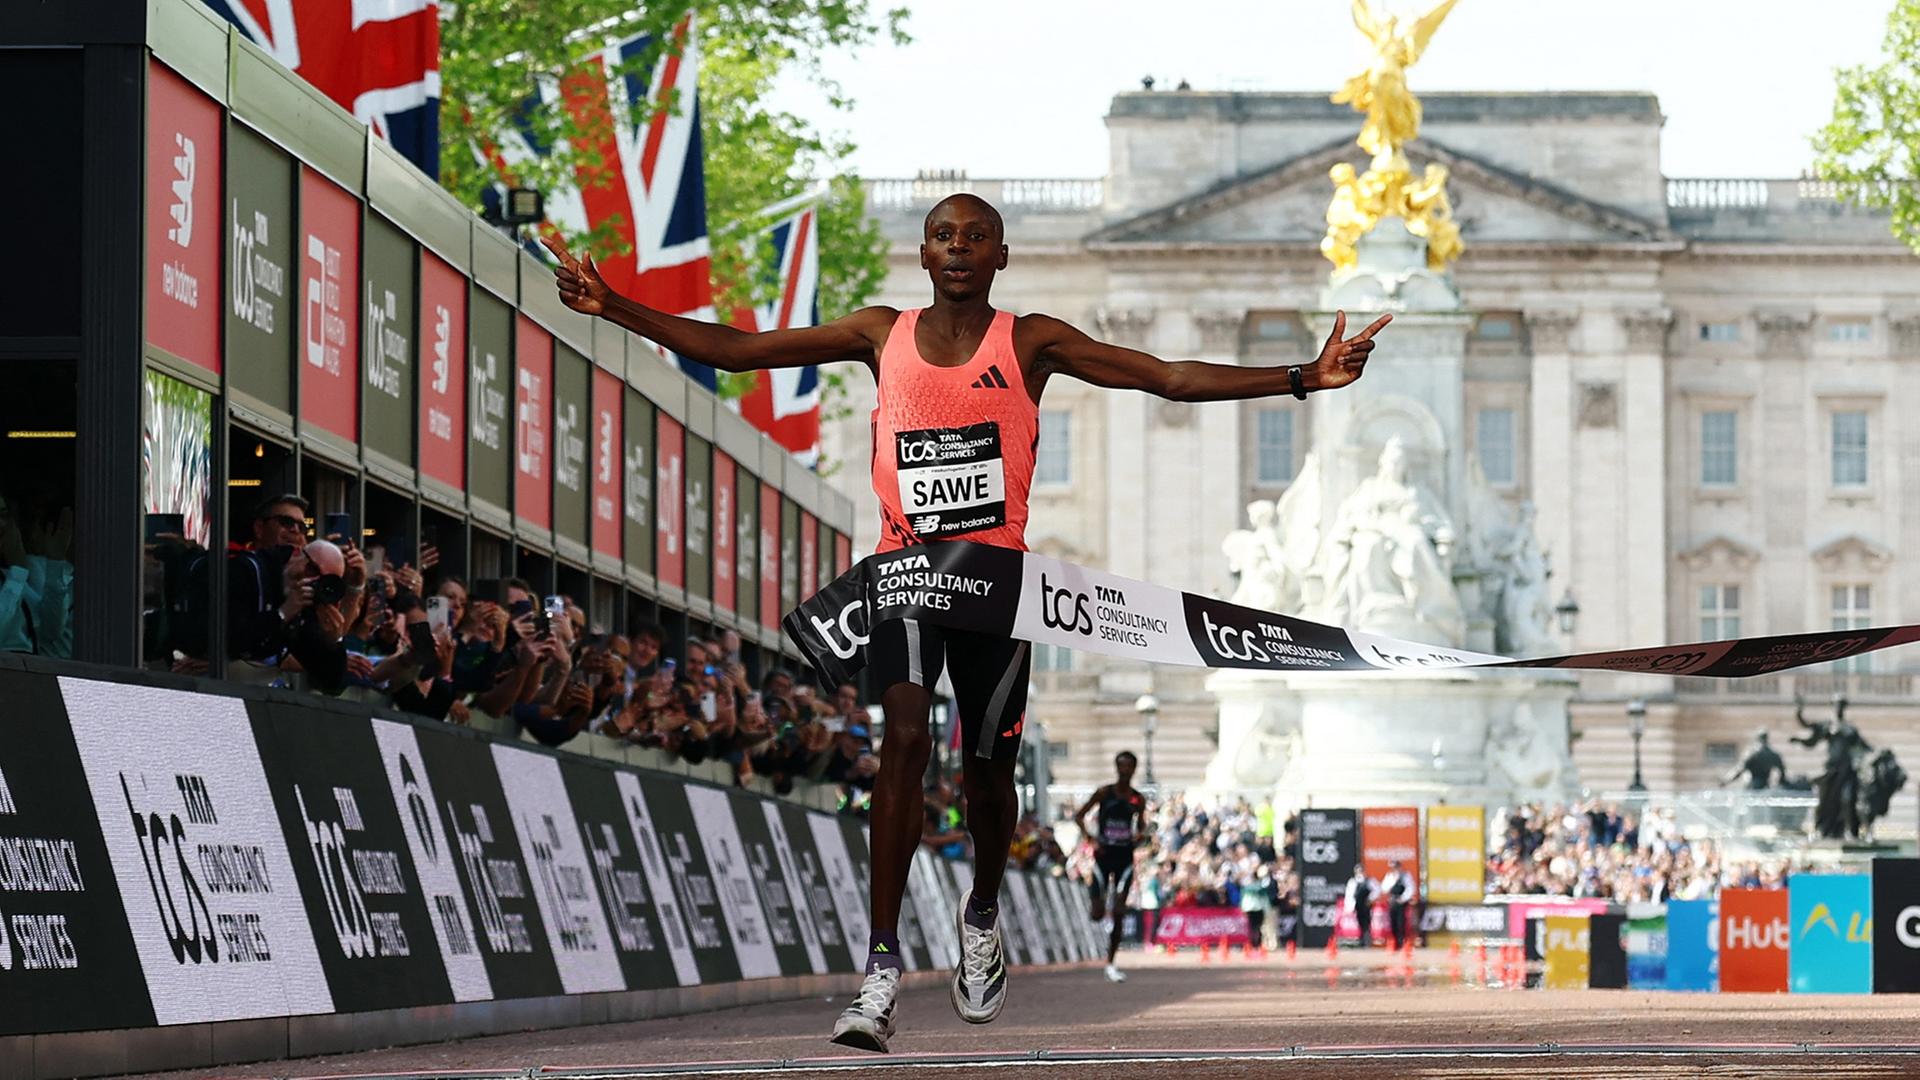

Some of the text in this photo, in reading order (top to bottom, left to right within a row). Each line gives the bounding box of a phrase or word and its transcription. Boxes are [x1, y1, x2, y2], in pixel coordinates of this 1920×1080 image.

[233, 197, 254, 323] tcs
[900, 437, 937, 463] tcs
[939, 434, 963, 442] TATA
[939, 437, 994, 451] CONSULTANCY
[940, 448, 976, 460] SERVICES
[913, 473, 989, 507] SAWE
[941, 515, 996, 532] new balance
[876, 554, 931, 576] TATA
[876, 571, 993, 597] CONSULTANCY
[1095, 585, 1126, 606] TATA
[876, 590, 953, 611] SERVICES
[1041, 572, 1093, 636] tcs
[810, 599, 870, 660] tc
[1096, 606, 1168, 634] CONSULTANCY
[1257, 622, 1293, 641] TATA
[1099, 625, 1148, 648] SERVICES
[1202, 611, 1271, 662] tcs
[1265, 641, 1345, 661] CONSULTANCY
[1274, 655, 1332, 667] SERVICES
[175, 774, 218, 825] TATA
[333, 786, 365, 831] TATA
[1302, 839, 1340, 863] tcs
[119, 771, 219, 965] tcs
[198, 844, 273, 893] CONSULTANCY
[294, 783, 375, 959] tcs
[11, 914, 78, 970] SERVICES
[217, 914, 271, 962] SERVICES
[1726, 915, 1789, 950] Hub
